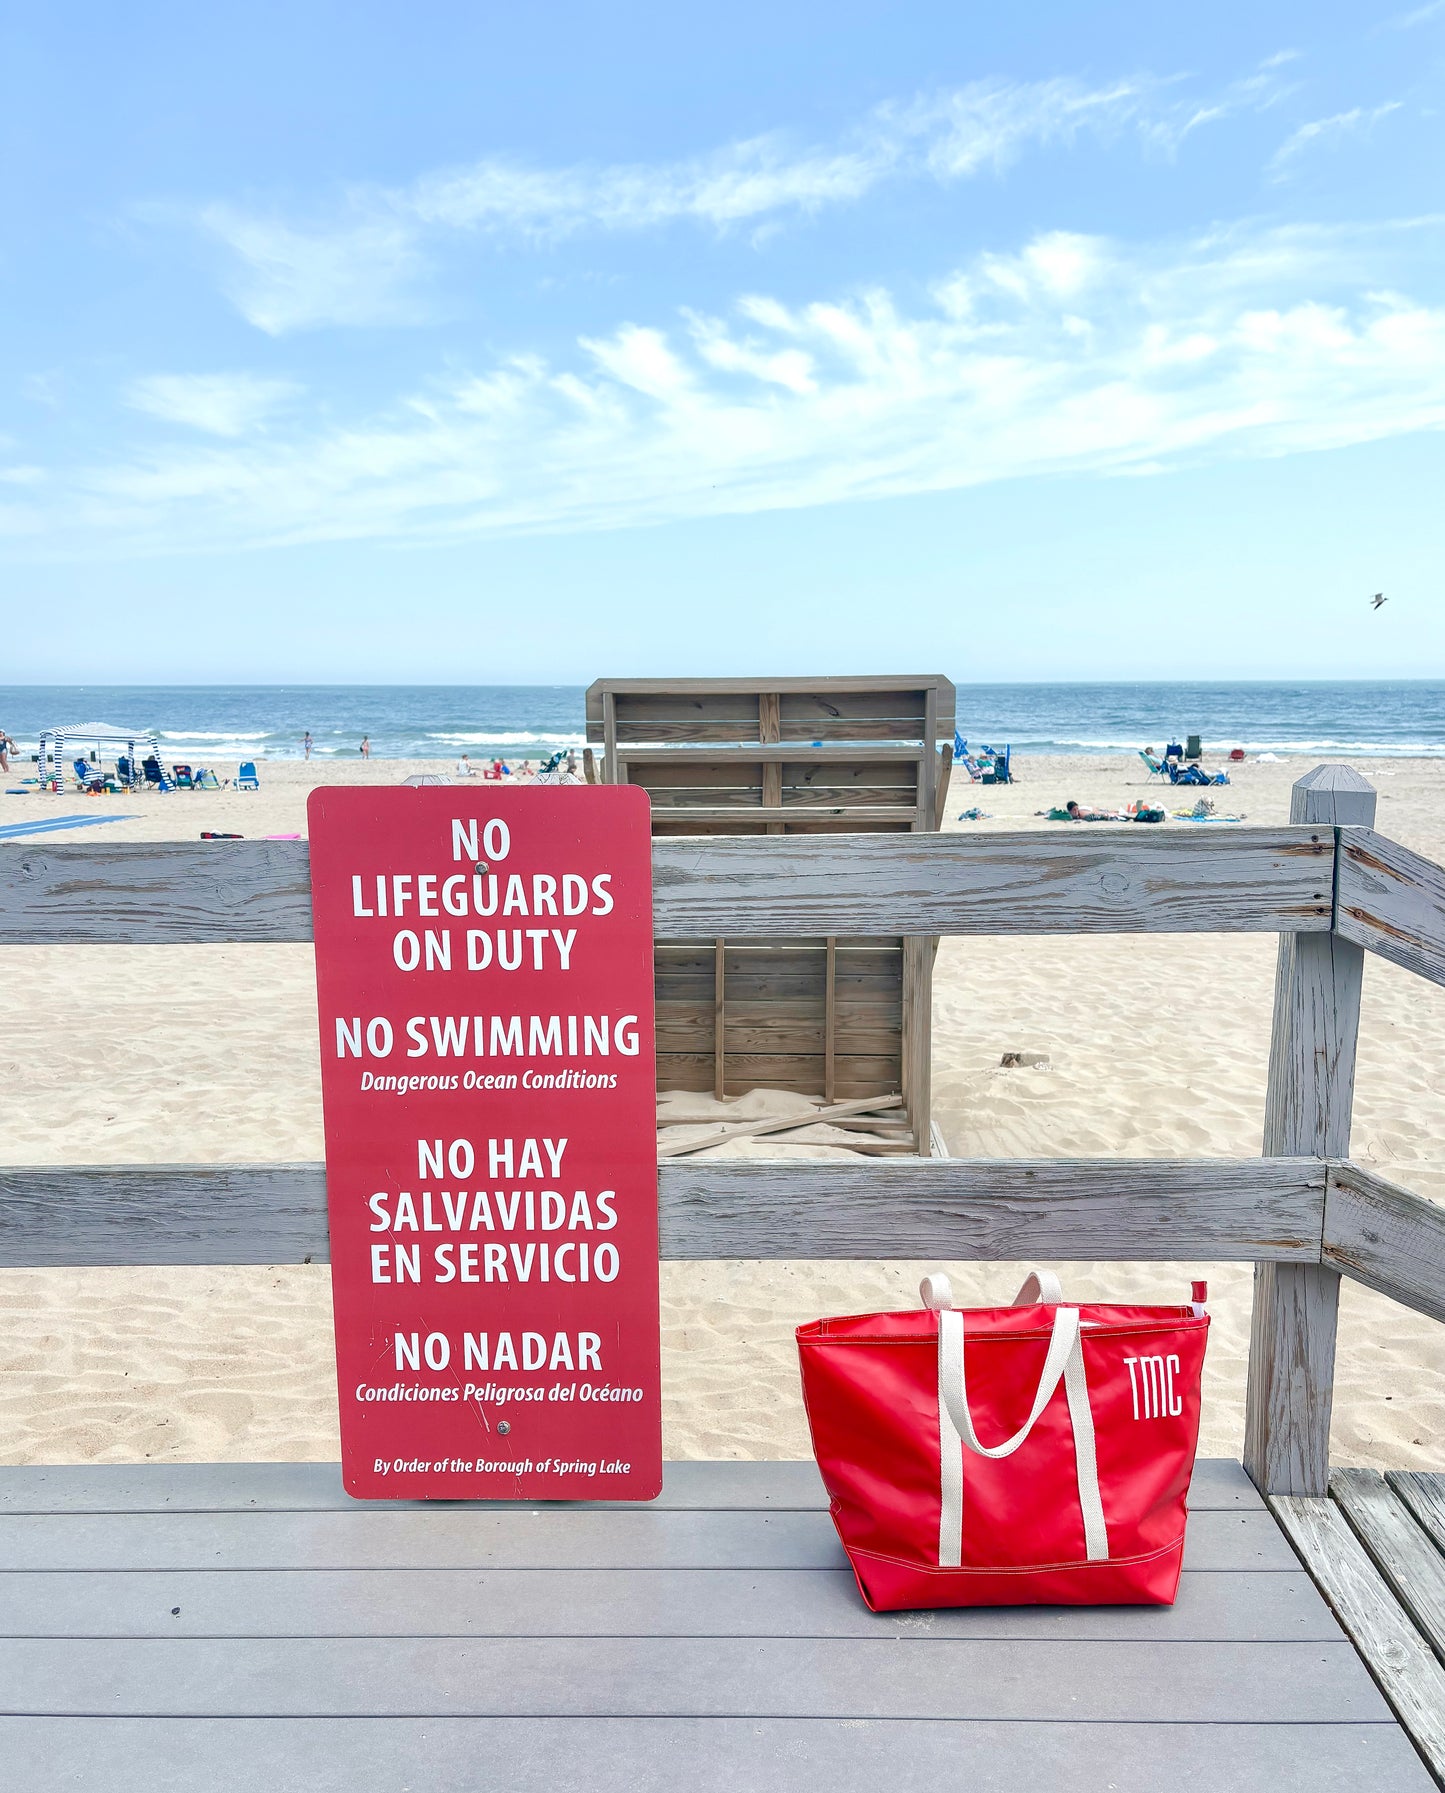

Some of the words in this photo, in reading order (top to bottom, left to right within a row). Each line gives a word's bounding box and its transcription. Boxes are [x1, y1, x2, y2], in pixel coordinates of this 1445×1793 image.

[451, 818, 511, 862] NO
[351, 873, 614, 916] LIFEGUARDS
[393, 929, 451, 971] ON
[466, 929, 577, 970] DUTY
[335, 1017, 394, 1058] NO
[406, 1014, 640, 1057] SWIMMING
[360, 1071, 459, 1095] Dangerous
[463, 1070, 518, 1089] Ocean
[522, 1069, 618, 1089] Conditions
[417, 1138, 475, 1179] NO
[488, 1138, 568, 1178] HAY
[368, 1190, 618, 1232] SALVAVIDAS
[370, 1243, 421, 1283] EN
[434, 1242, 620, 1283] SERVICIO
[394, 1332, 450, 1371] NO
[463, 1331, 603, 1371] NADAR
[355, 1382, 460, 1402] Condiciones
[463, 1382, 544, 1406] Peligrosa
[548, 1382, 576, 1402] del
[580, 1382, 644, 1402] Océano
[1123, 1354, 1182, 1420] TMC
[373, 1458, 391, 1475] By
[394, 1458, 431, 1473] Order
[434, 1458, 449, 1475] of
[450, 1458, 472, 1473] the
[475, 1458, 533, 1475] Borough
[535, 1458, 553, 1475] of
[553, 1458, 596, 1476] Spring
[599, 1459, 631, 1474] Lake
